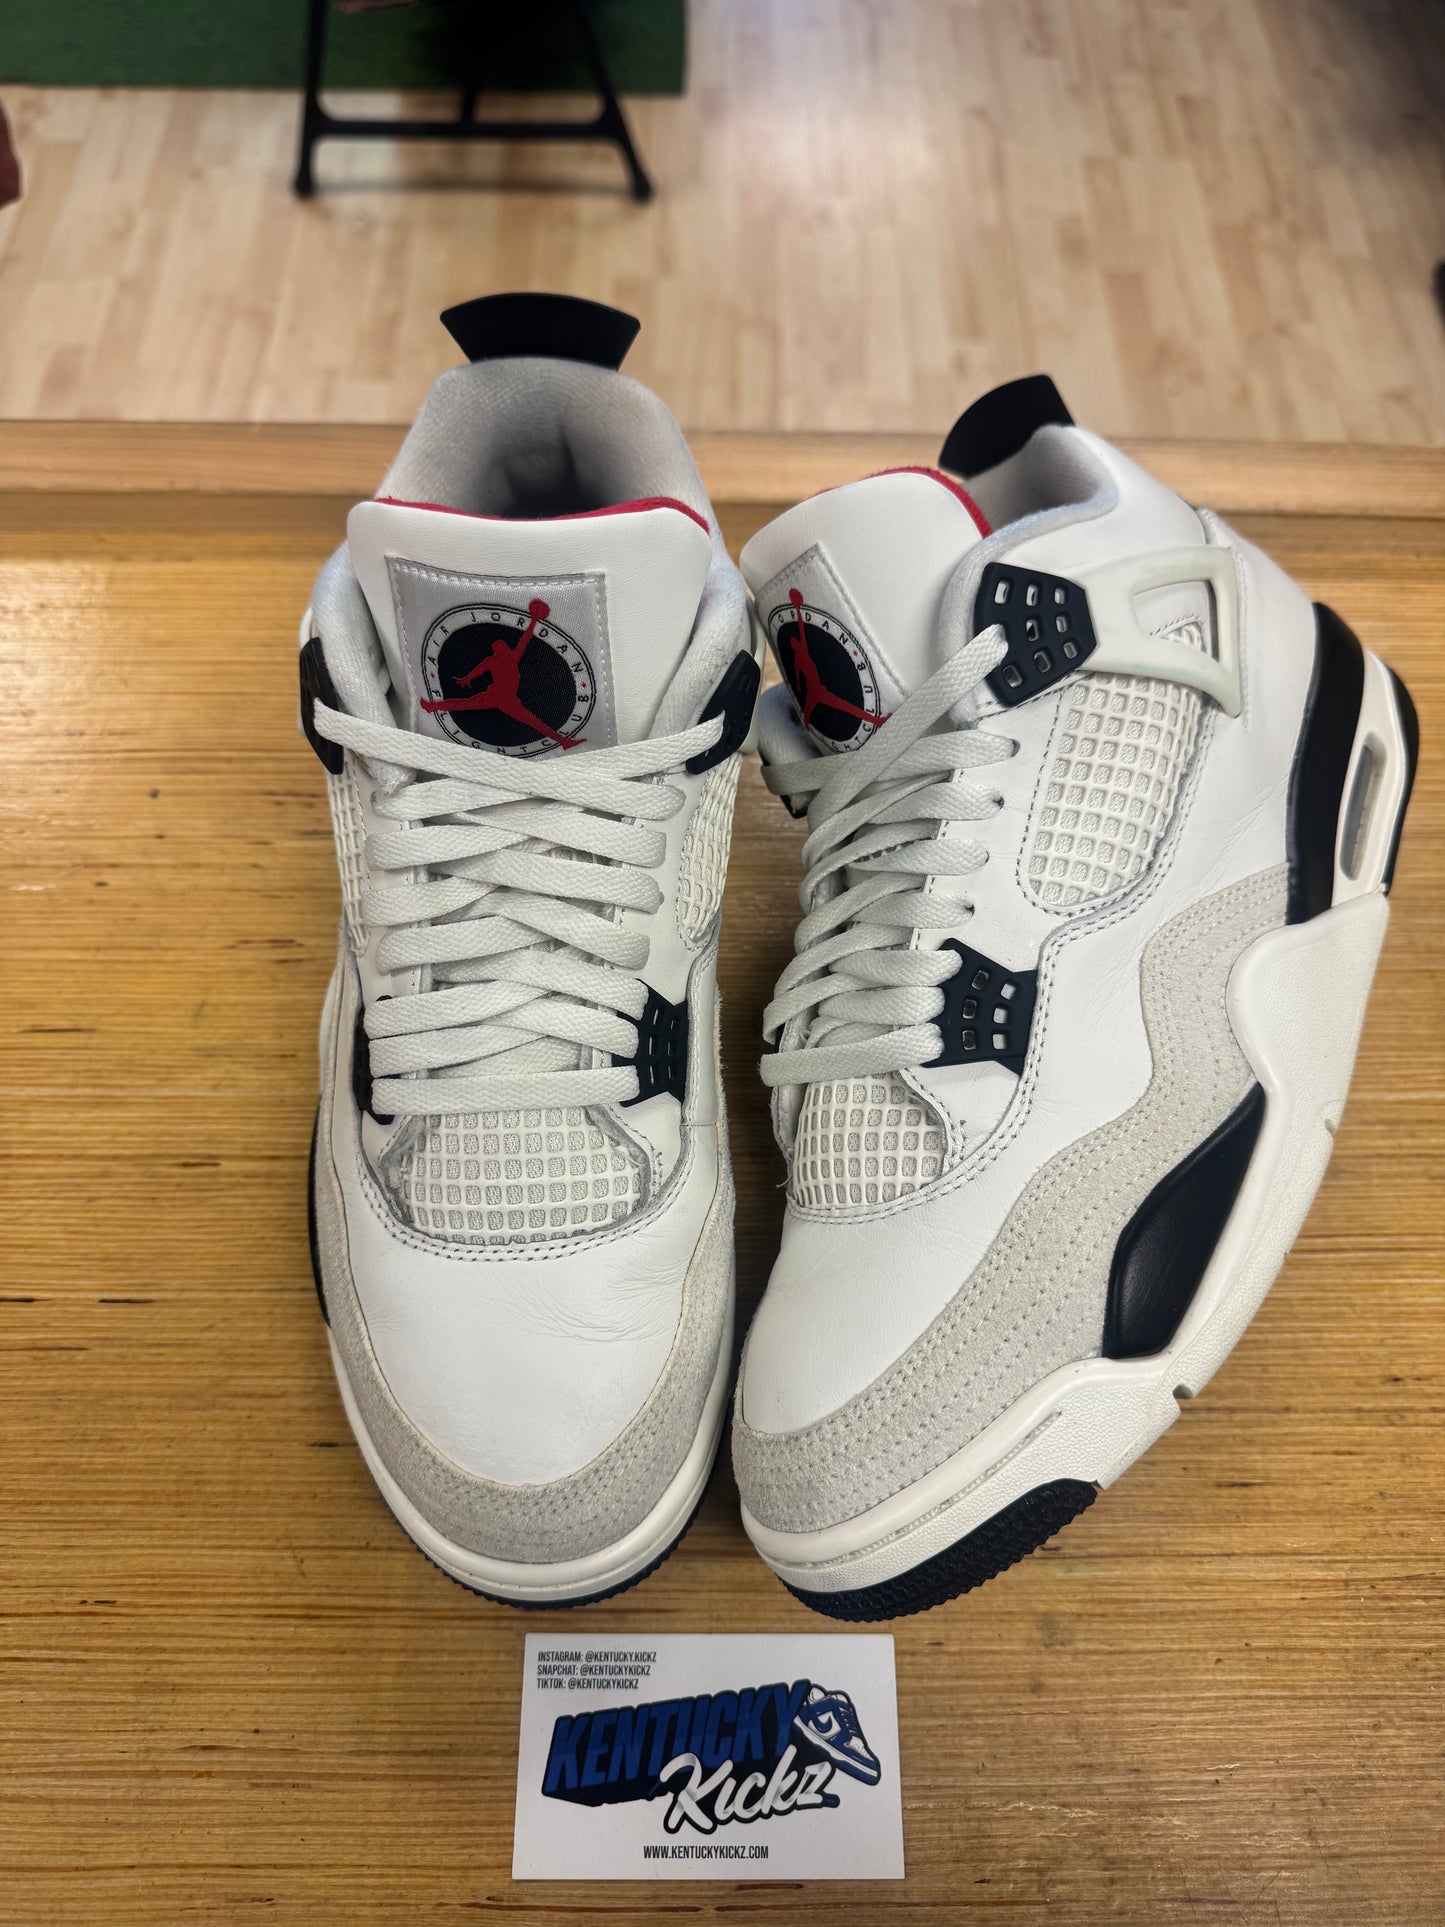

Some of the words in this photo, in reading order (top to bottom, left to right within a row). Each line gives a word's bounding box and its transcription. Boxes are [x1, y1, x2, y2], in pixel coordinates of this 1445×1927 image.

[426, 625, 451, 666] AIR
[471, 611, 585, 673] JORDAN
[431, 689, 528, 754] FLIGHT
[542, 695, 589, 747] CLUB
[537, 1664, 579, 1675] SNAPCHAT:
[580, 1664, 651, 1676] @KENTUCKYKICKZ
[538, 1650, 584, 1662] INSTAGRAM:
[585, 1650, 657, 1662] @KENTUCKY.KICKZ
[537, 1677, 567, 1689] TIKTOK:
[568, 1677, 639, 1689] @KENTUCKYKICKZ
[543, 1679, 811, 1795] KENTUCKY
[659, 1743, 832, 1830] Kickz
[643, 1845, 769, 1859] WWW.KENTUCKYKICKZ.COM
